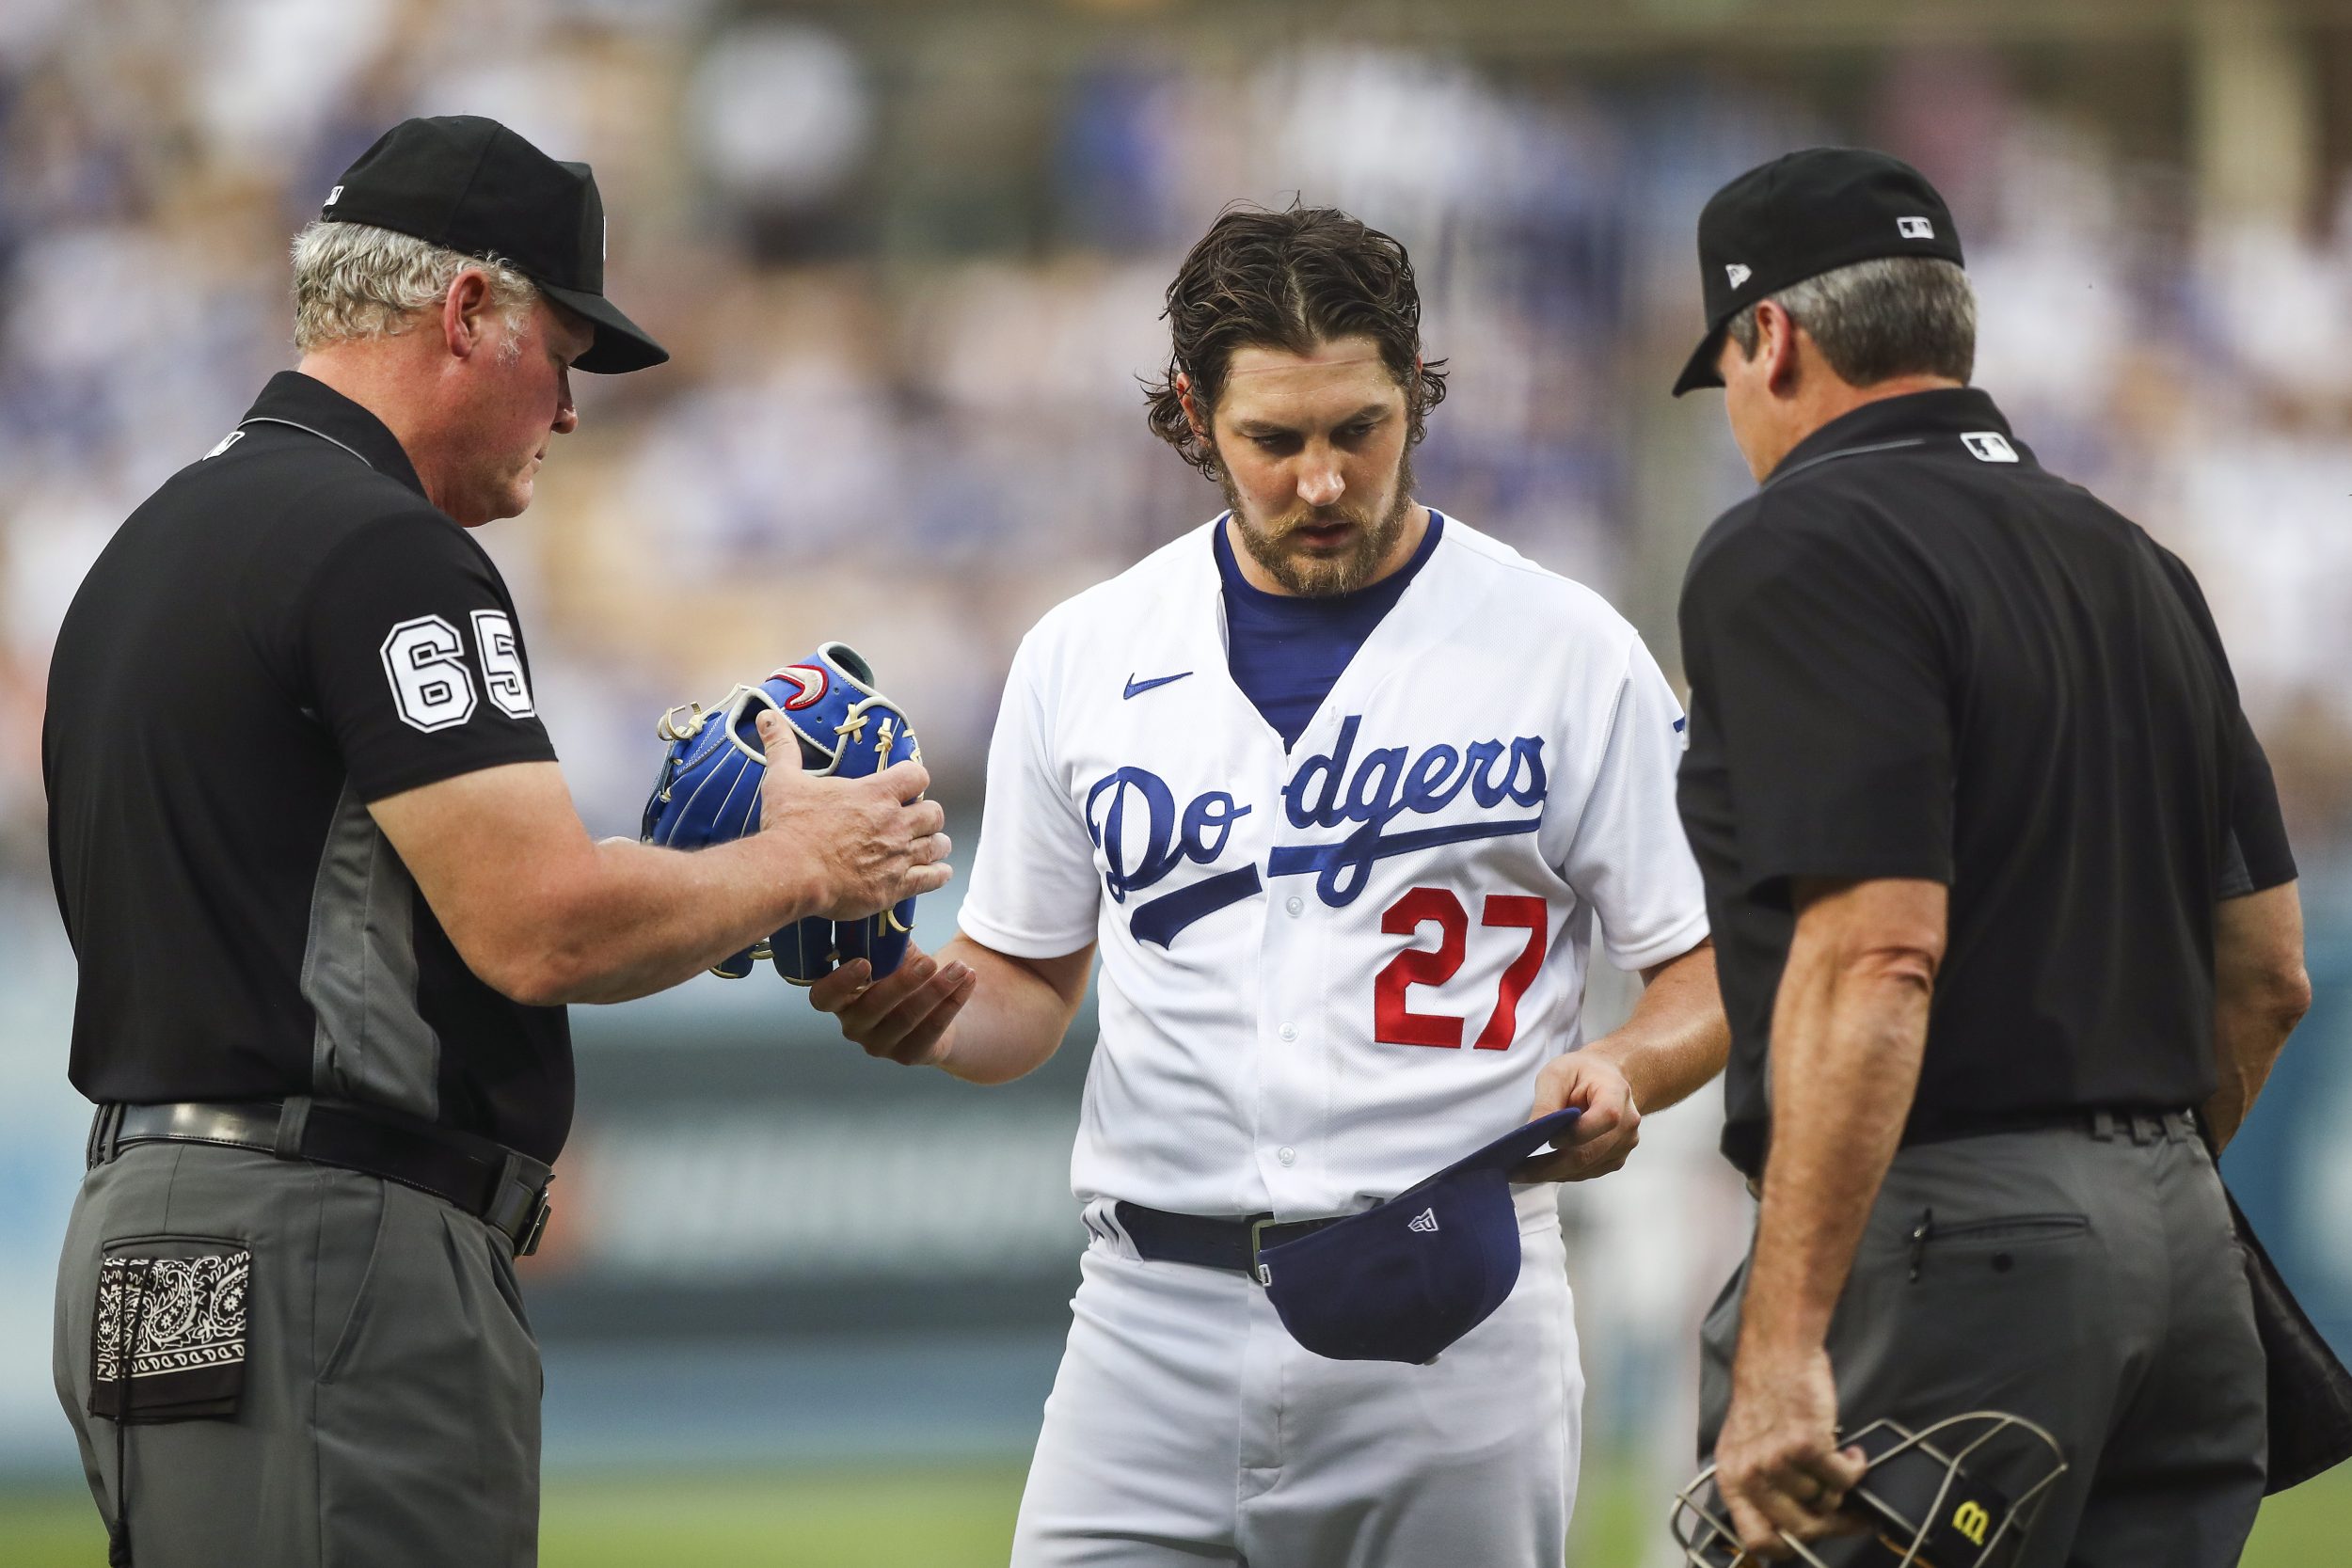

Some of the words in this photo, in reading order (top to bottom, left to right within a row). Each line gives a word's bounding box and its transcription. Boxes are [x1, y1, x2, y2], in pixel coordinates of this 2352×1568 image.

[379, 609, 535, 734] 65
[1086, 714, 1548, 908] Dodgers
[1375, 887, 1548, 1051] 27
